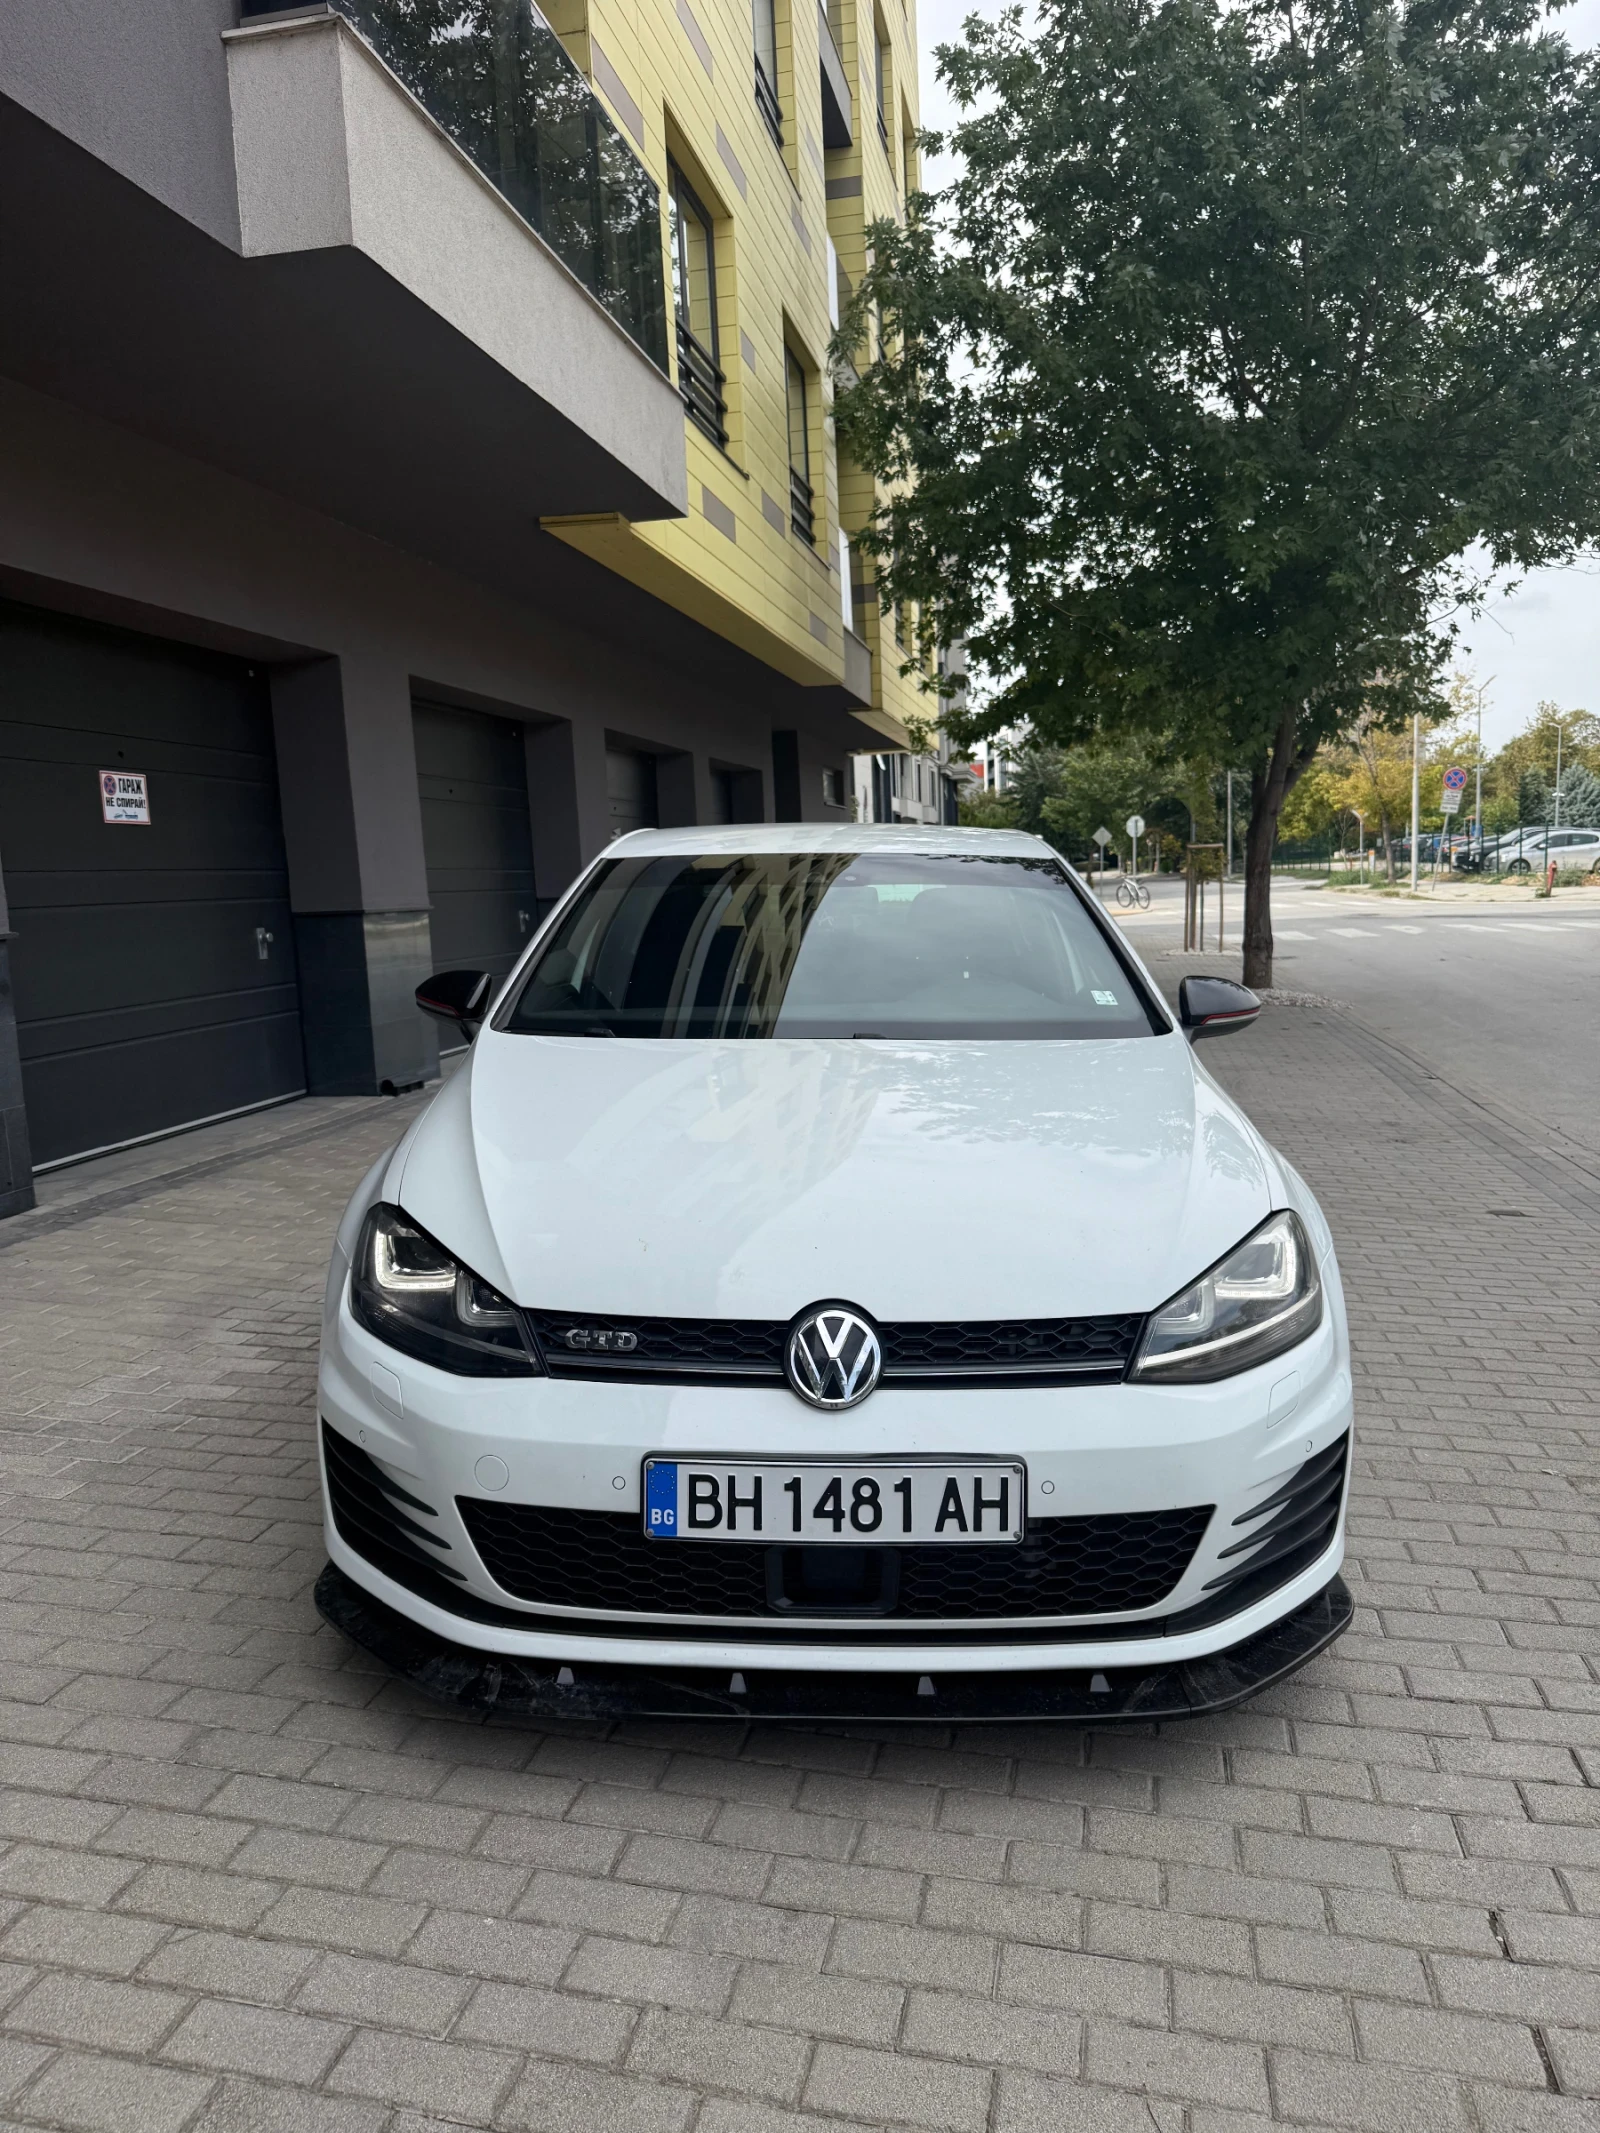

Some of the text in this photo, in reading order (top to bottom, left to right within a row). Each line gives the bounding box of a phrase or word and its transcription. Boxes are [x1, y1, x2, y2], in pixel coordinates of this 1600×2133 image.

[118, 778, 143, 795] ГАРАЖ
[105, 797, 146, 809] НЕ СПИРАЙ!
[565, 1329, 638, 1351] GTD
[687, 1473, 1009, 1533] BH 1481 AH
[651, 1508, 674, 1525] BG
